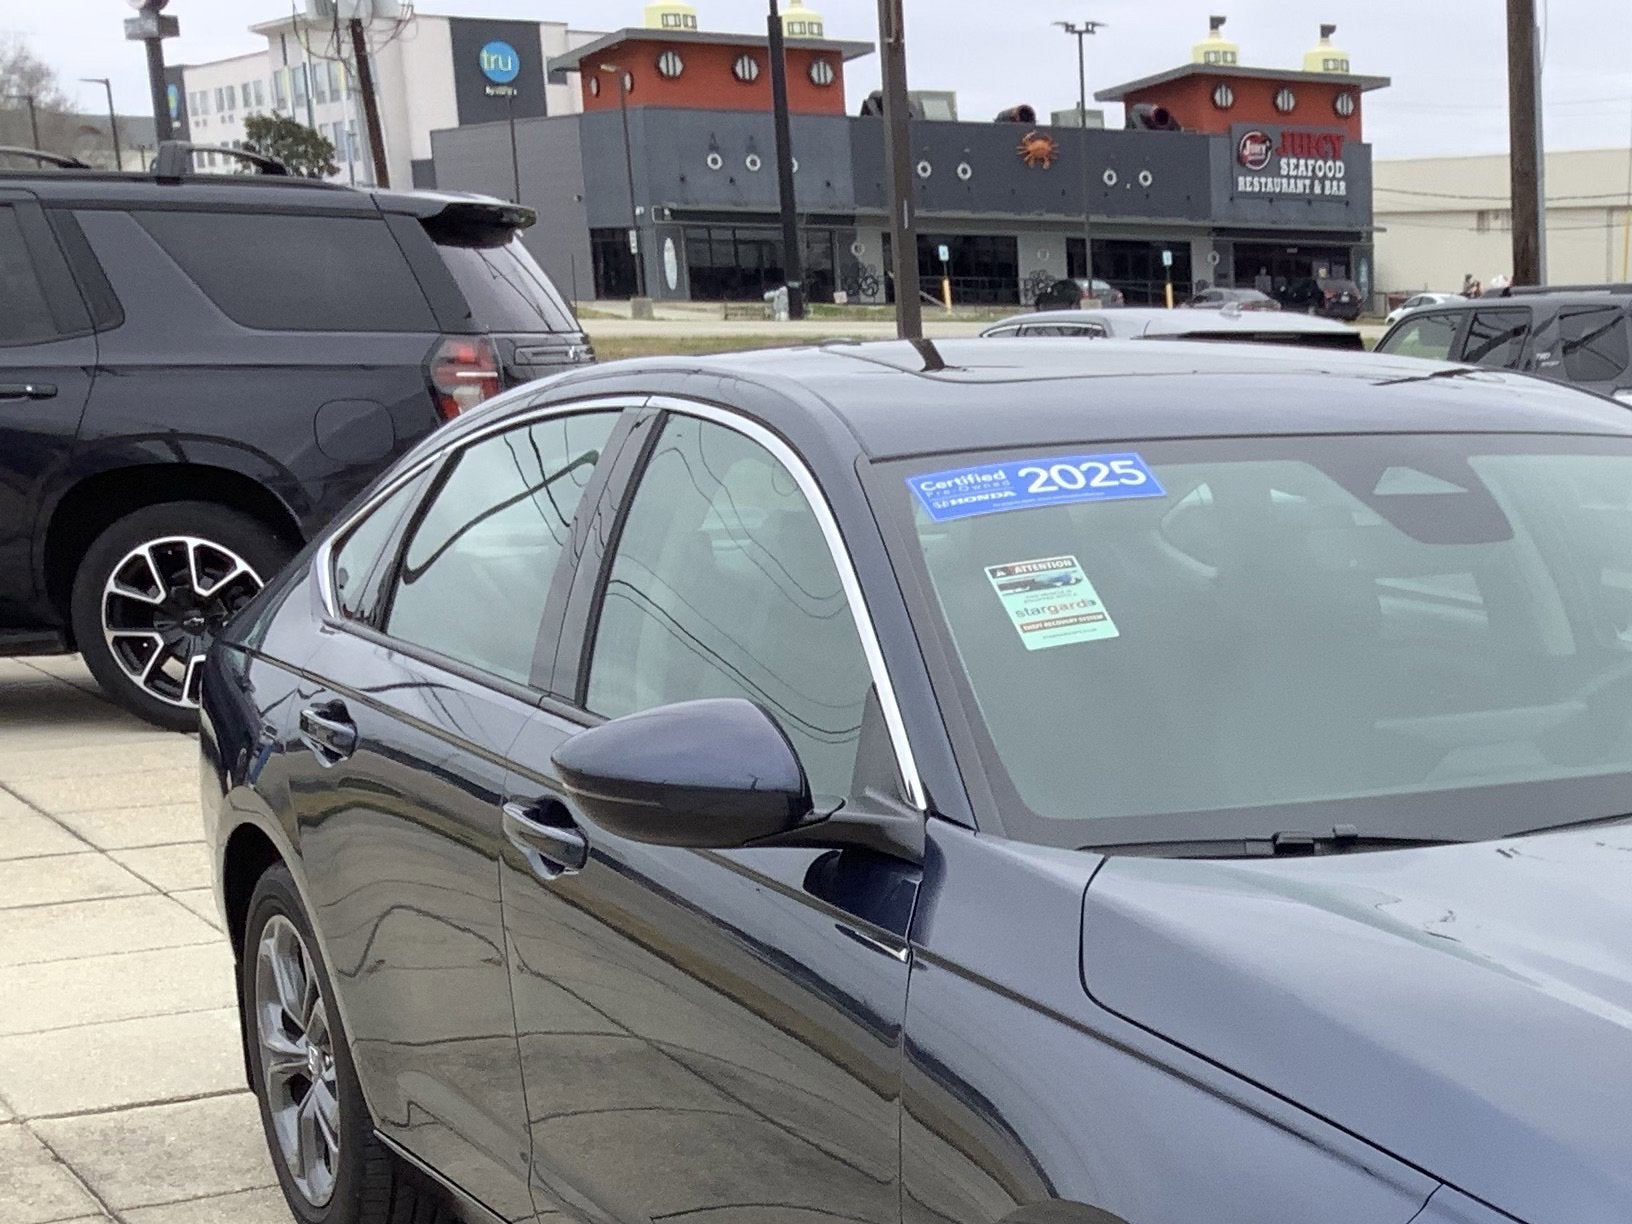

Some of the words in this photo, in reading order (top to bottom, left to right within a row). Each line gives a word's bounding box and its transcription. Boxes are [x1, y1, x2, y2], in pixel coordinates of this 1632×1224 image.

[480, 49, 511, 71] tru
[1275, 130, 1344, 160] JUICY
[1280, 158, 1345, 178] SEAFOOD
[1238, 176, 1311, 193] RESTAURANT
[1314, 179, 1322, 194] &
[1324, 180, 1346, 196] BAR
[919, 469, 1008, 492] Certified
[1017, 459, 1147, 493] 2025
[950, 490, 1017, 506] HONDA
[1014, 559, 1073, 574] ATTENTION
